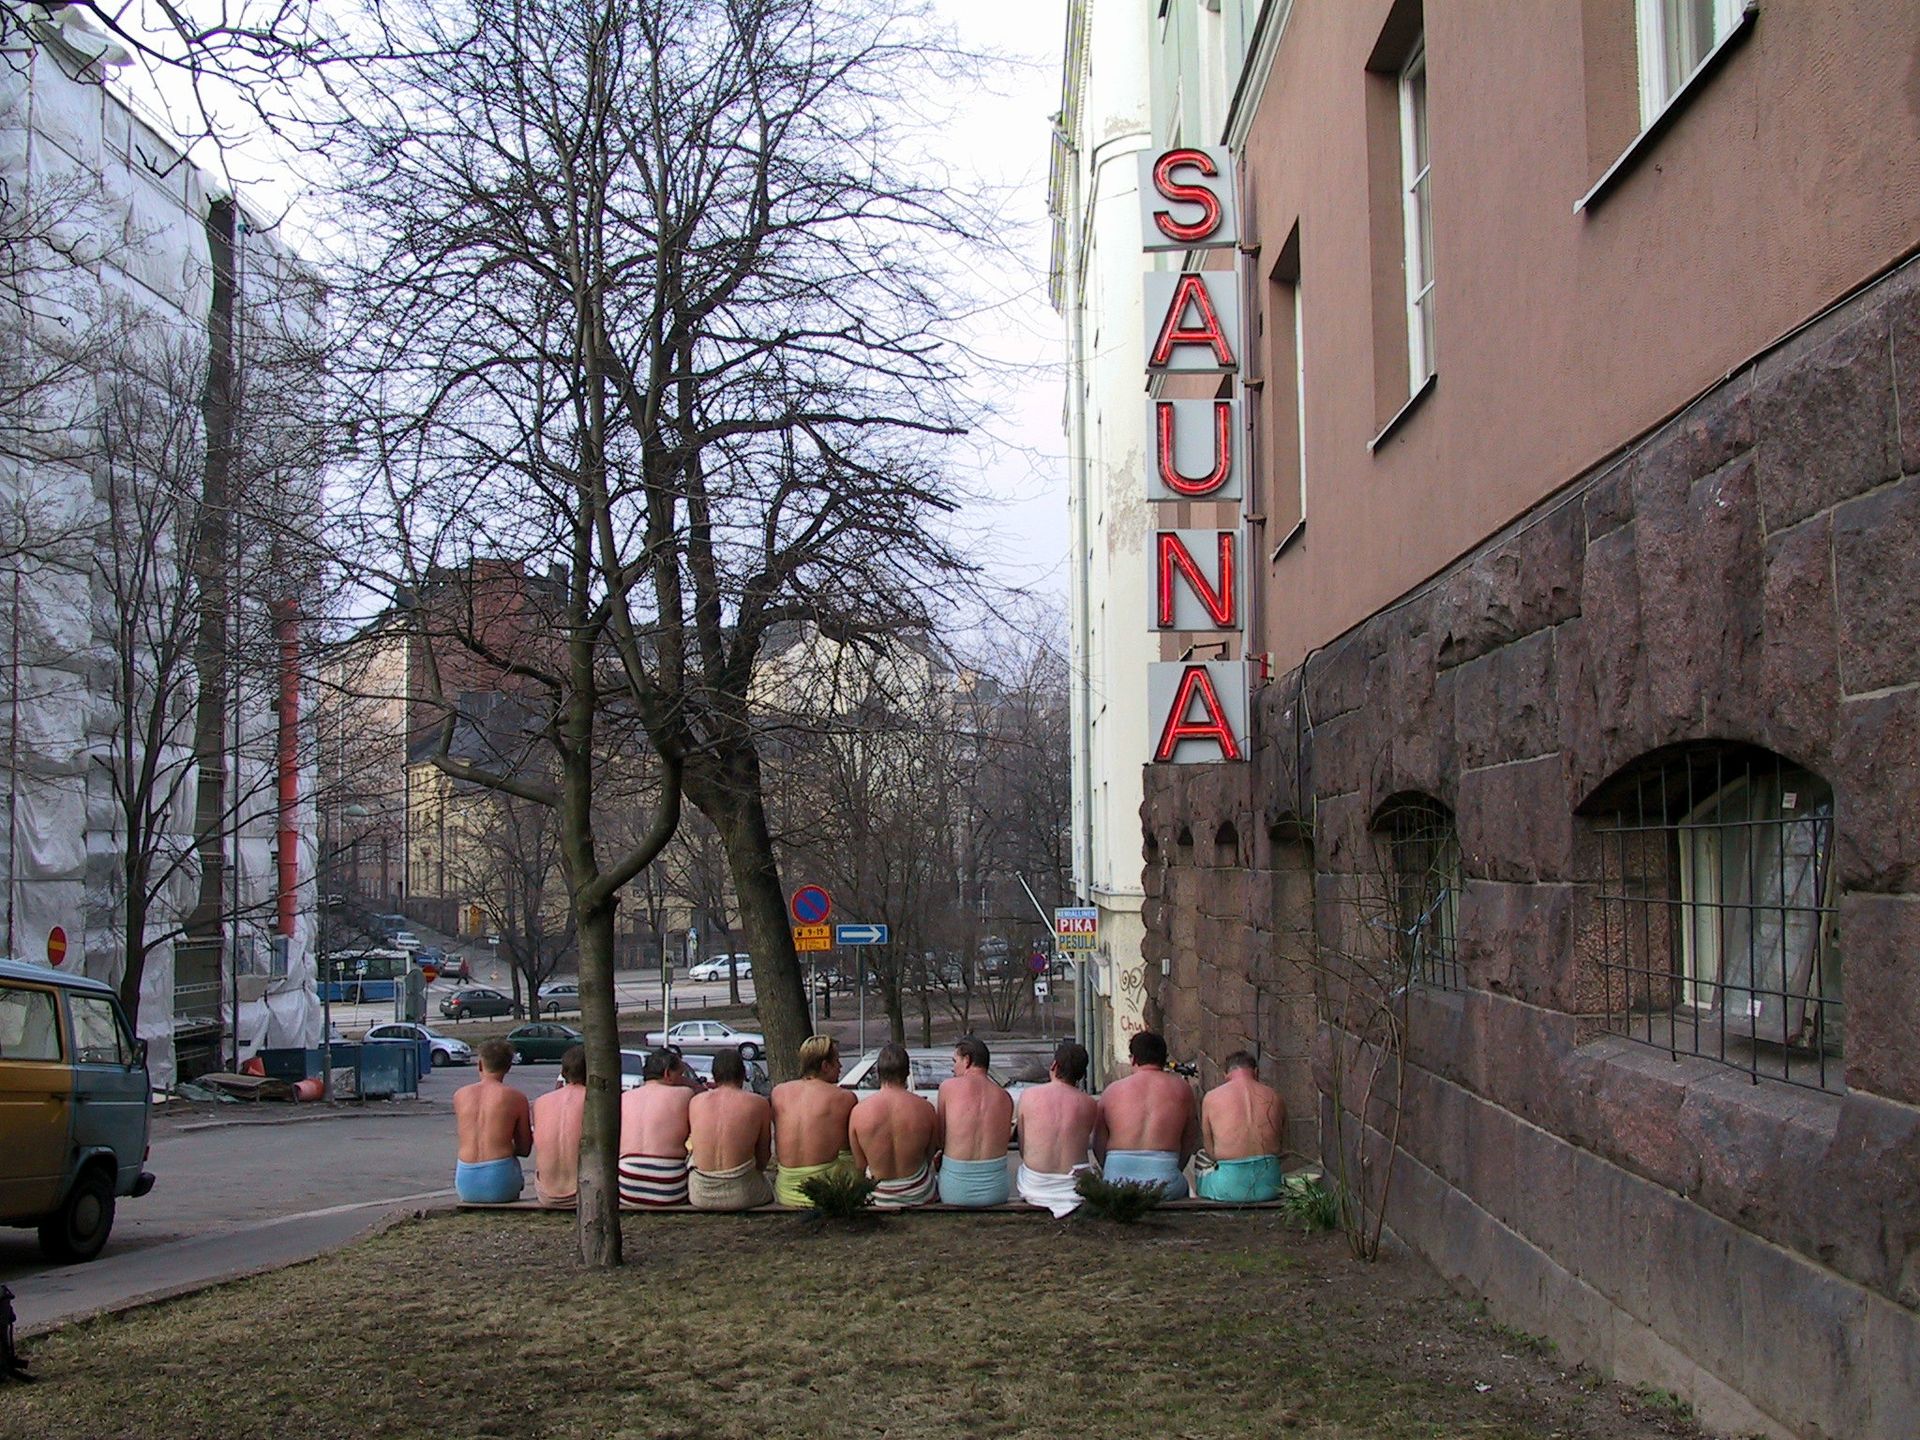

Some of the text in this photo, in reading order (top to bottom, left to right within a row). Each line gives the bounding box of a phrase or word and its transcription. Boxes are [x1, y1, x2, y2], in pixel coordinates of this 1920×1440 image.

[1152, 148, 1241, 762] SAUNA
[1060, 919, 1093, 932] PIKA
[1059, 935, 1097, 949] PESULA
